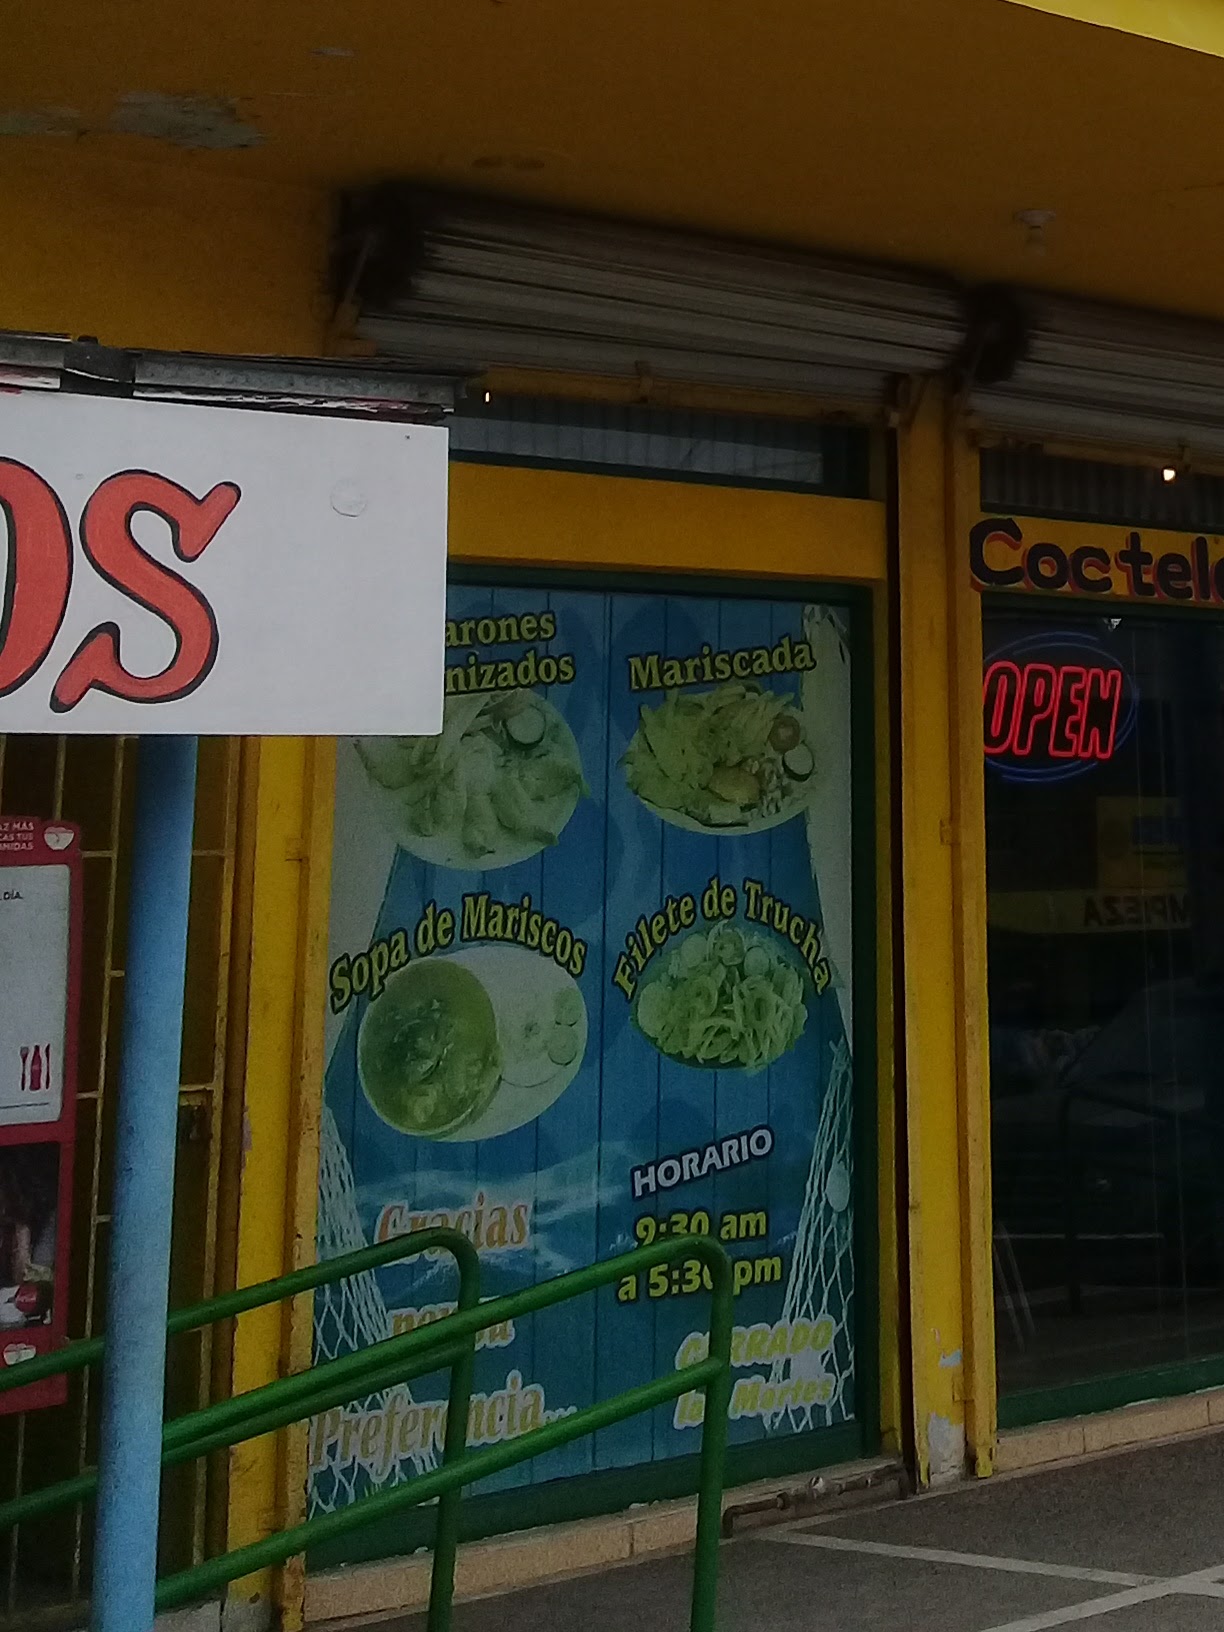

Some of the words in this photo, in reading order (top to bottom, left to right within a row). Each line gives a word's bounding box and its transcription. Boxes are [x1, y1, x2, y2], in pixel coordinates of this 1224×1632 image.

[445, 612, 556, 647] arones
[444, 649, 575, 692] nizados
[629, 636, 817, 691] Mariscada
[982, 660, 1122, 760] OPEN
[327, 928, 410, 1013] Sopa
[415, 894, 456, 953] de
[460, 890, 588, 976] Mariscos
[614, 892, 696, 1001] Filete
[701, 877, 737, 921] de
[743, 879, 833, 996] Trucha
[633, 1129, 773, 1197] HORARIO
[635, 1210, 711, 1247] 9:30
[720, 1210, 768, 1241] am
[618, 1273, 637, 1302] a
[732, 1255, 783, 1297] pm
[678, 1317, 835, 1369] CRRADO
[730, 1375, 835, 1418] Martes
[311, 1374, 542, 1478] Preferncia
